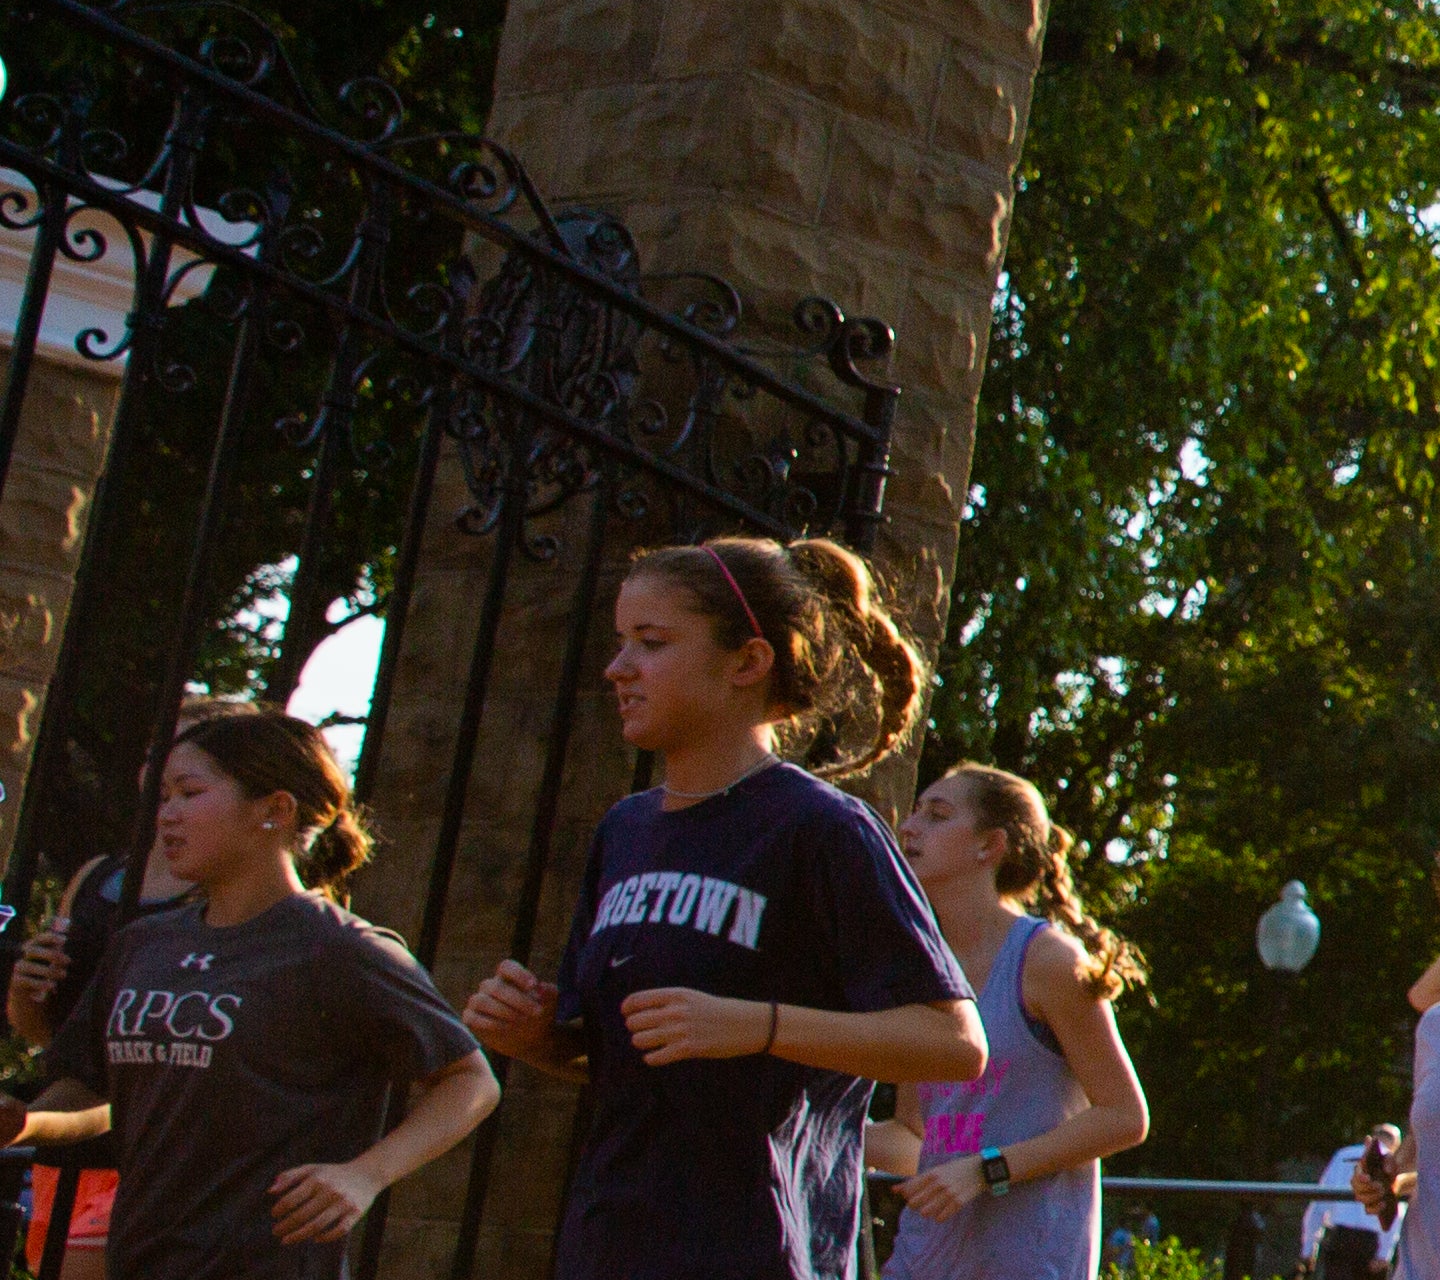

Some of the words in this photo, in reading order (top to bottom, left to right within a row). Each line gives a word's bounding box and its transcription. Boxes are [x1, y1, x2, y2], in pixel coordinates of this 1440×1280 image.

[591, 871, 769, 951] RGETOWN
[107, 988, 243, 1041] RPCS
[107, 1041, 154, 1064] TRACK
[169, 1042, 214, 1069] FIELD
